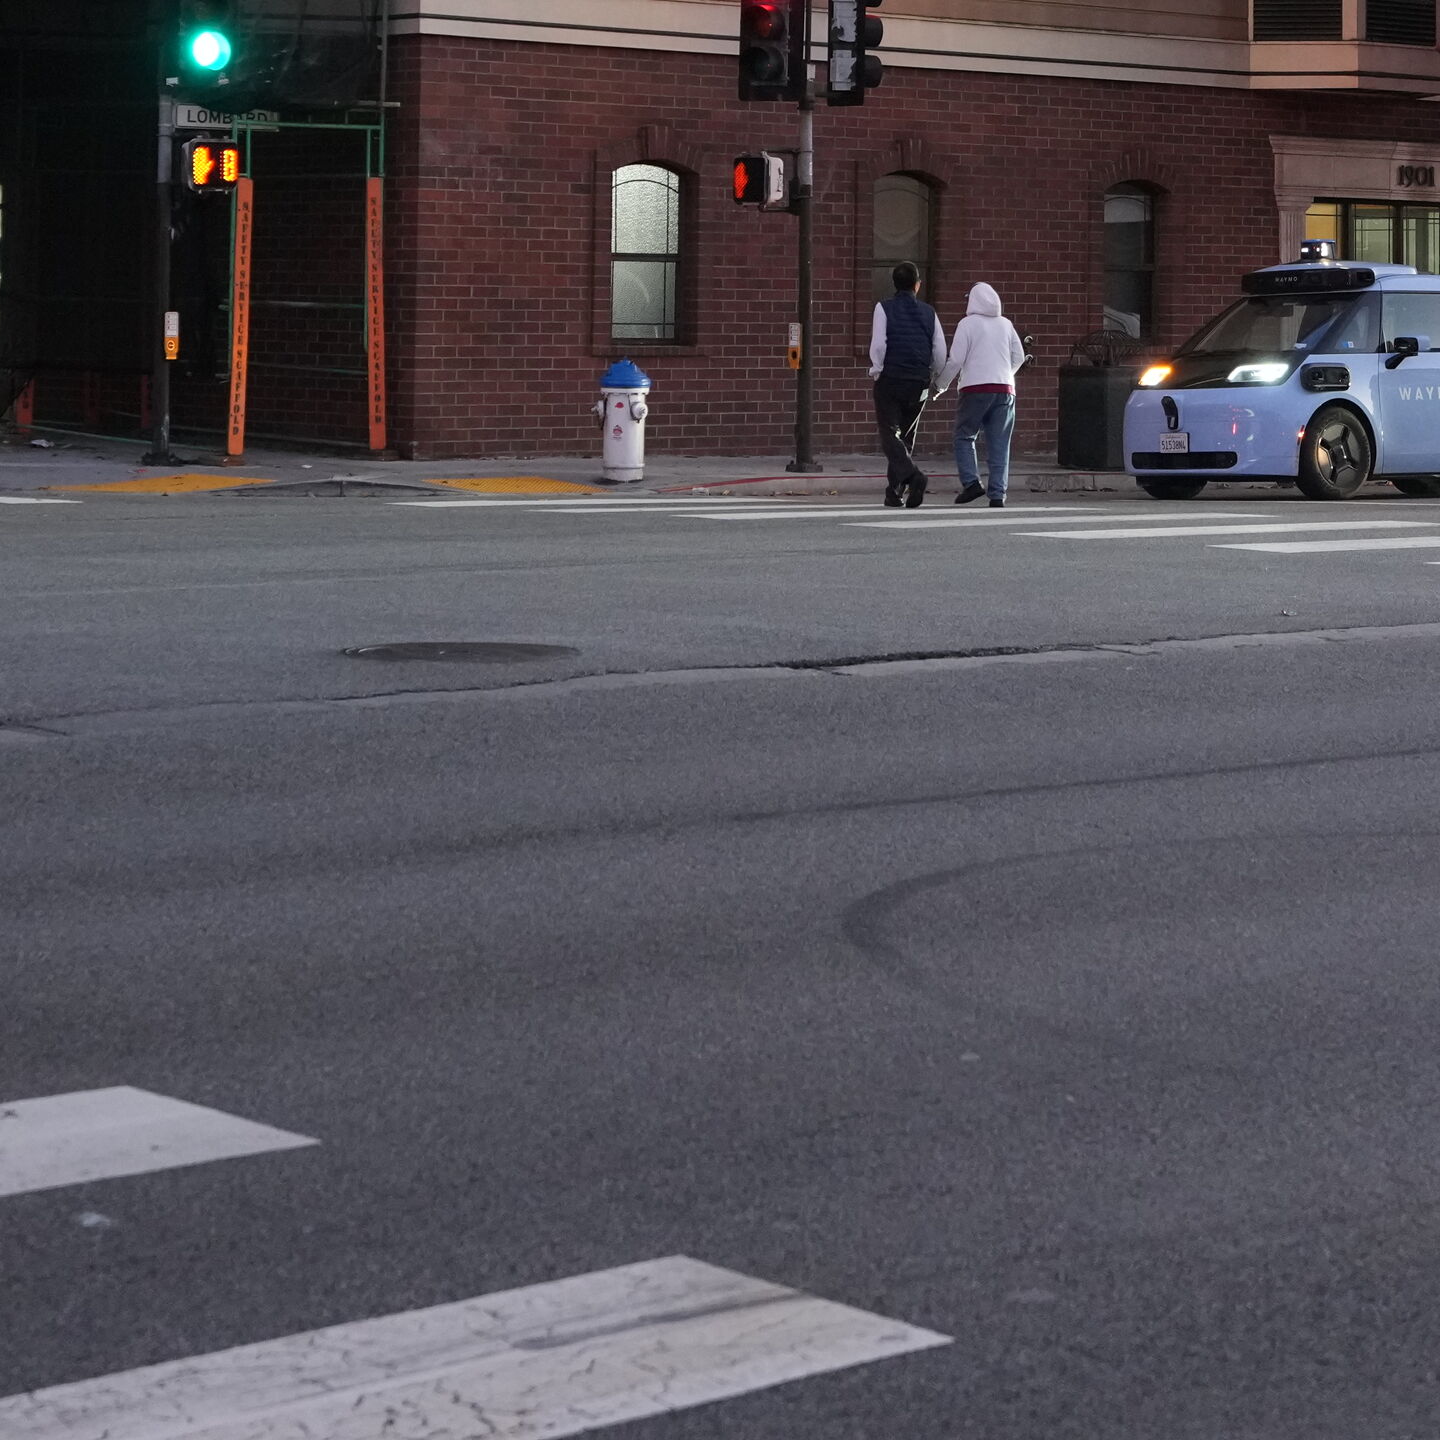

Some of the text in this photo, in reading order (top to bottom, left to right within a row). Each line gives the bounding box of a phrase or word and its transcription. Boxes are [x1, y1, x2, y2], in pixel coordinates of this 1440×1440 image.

[1397, 164, 1436, 188] 1901
[370, 263, 381, 336] SERVICE
[1274, 275, 1298, 283] WAYMO
[232, 201, 250, 436] SAFETY SERVICE SCAFFOLD
[371, 341, 382, 425] SCAFFOLD
